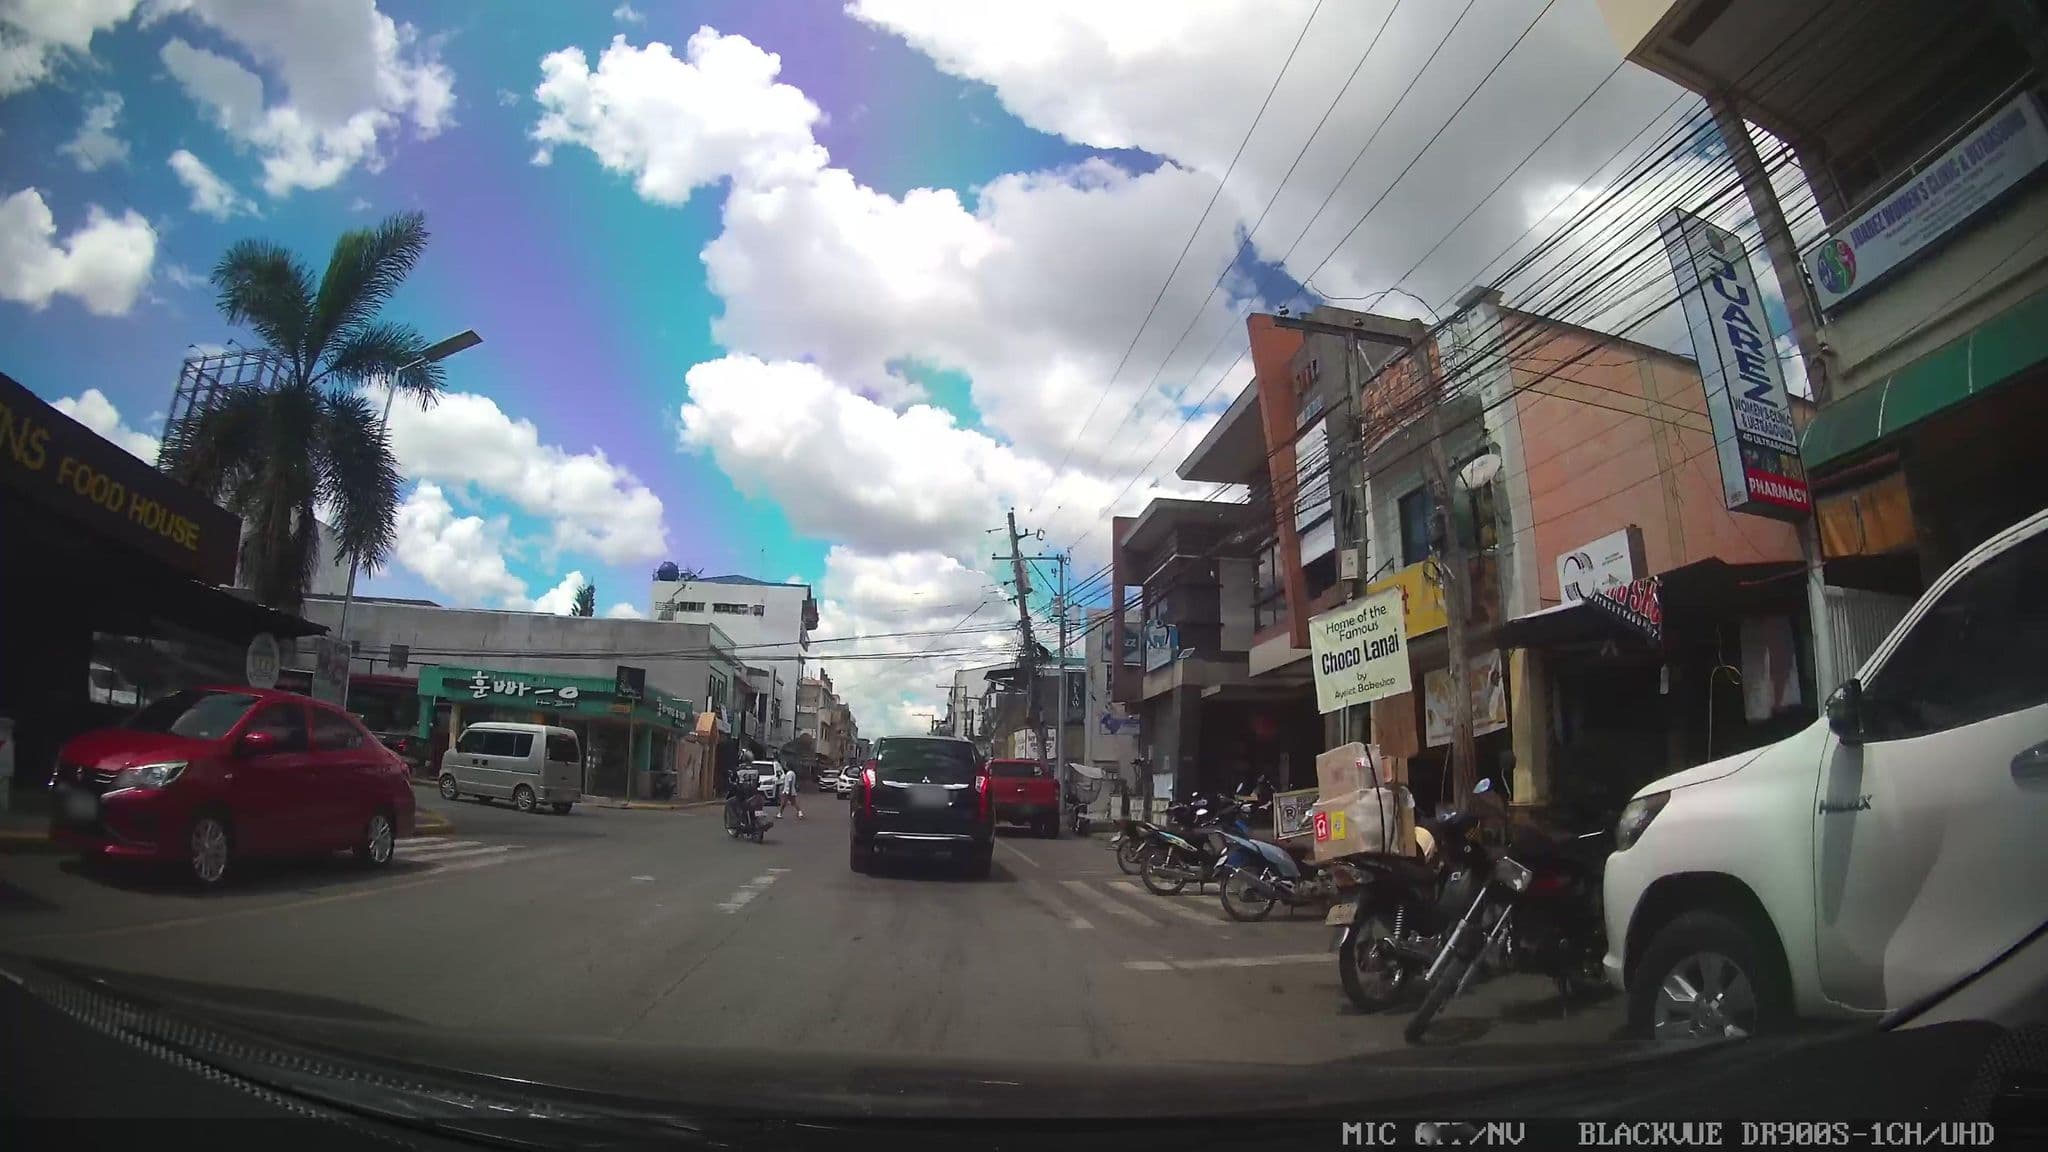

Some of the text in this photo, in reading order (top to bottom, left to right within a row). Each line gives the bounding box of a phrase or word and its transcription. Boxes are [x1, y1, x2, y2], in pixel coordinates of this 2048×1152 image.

[57, 456, 126, 513] FOOD
[128, 492, 201, 551] HOUSE
[1748, 477, 1807, 504] PHARMACY
[1326, 605, 1387, 635] Home of the
[1339, 620, 1379, 642] Famous
[1321, 627, 1400, 676] Choco Lanai
[1356, 672, 1367, 681] by
